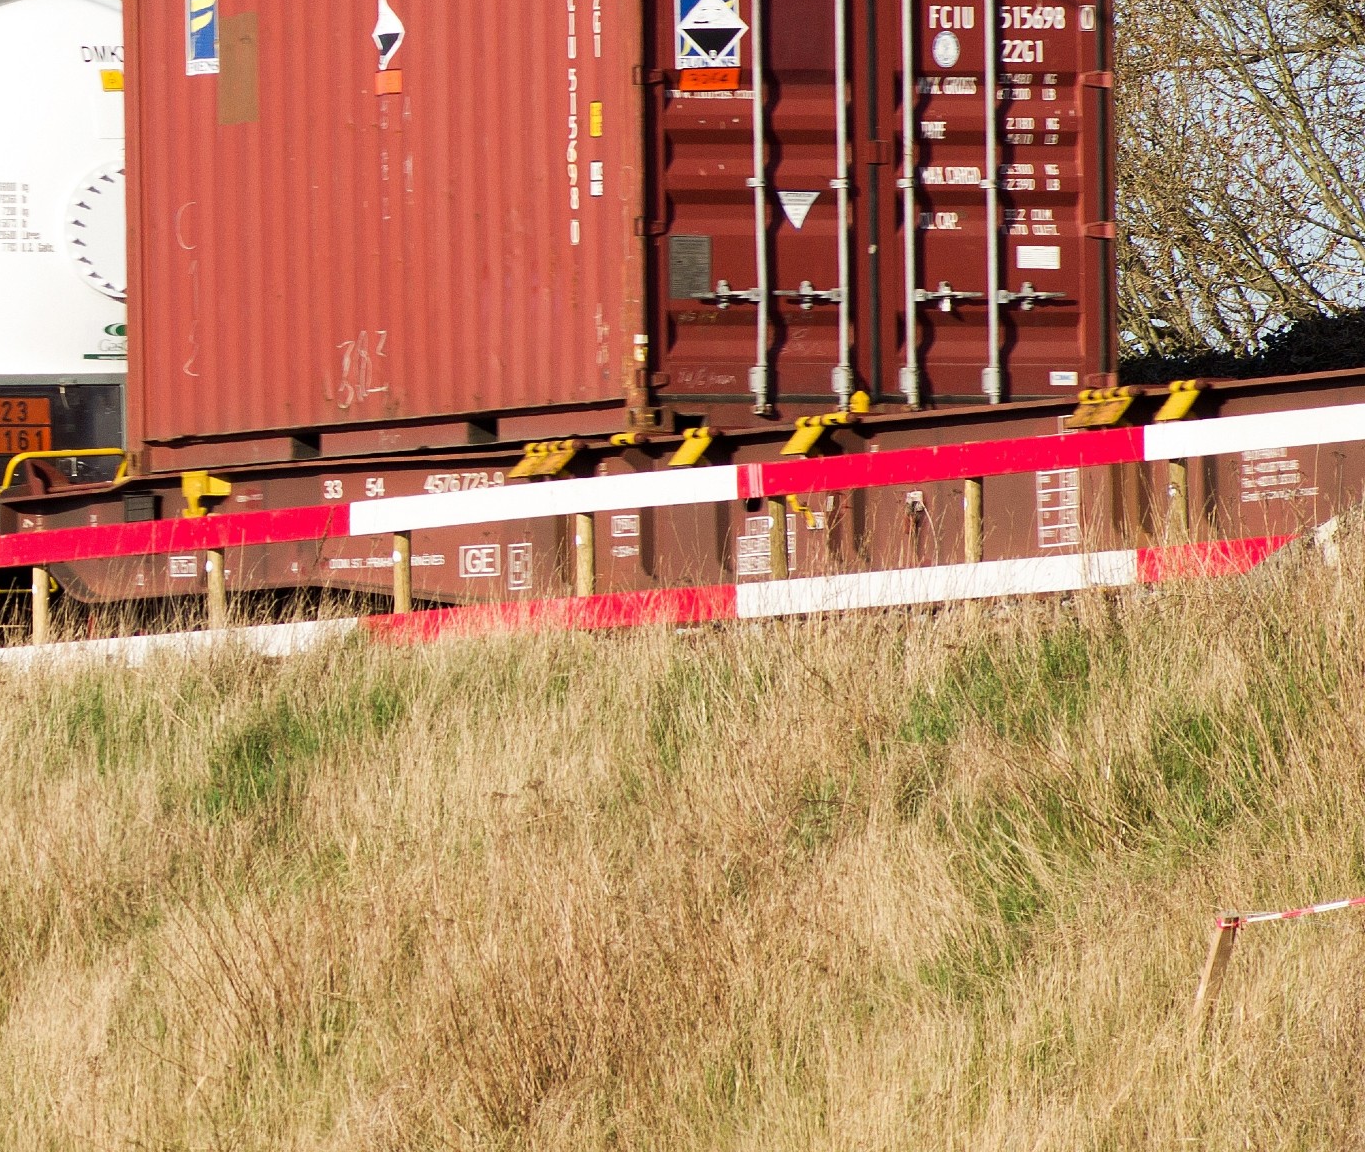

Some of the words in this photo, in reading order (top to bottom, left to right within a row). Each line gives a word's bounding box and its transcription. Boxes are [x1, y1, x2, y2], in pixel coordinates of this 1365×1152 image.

[928, 5, 975, 29] FCIU
[1000, 6, 1066, 30] 515698
[1001, 39, 1044, 63] 22G1
[567, 69, 580, 209] 515698
[1, 400, 28, 423] 23
[323, 479, 343, 499] 33
[365, 477, 386, 497] 54
[465, 548, 495, 574] GE
